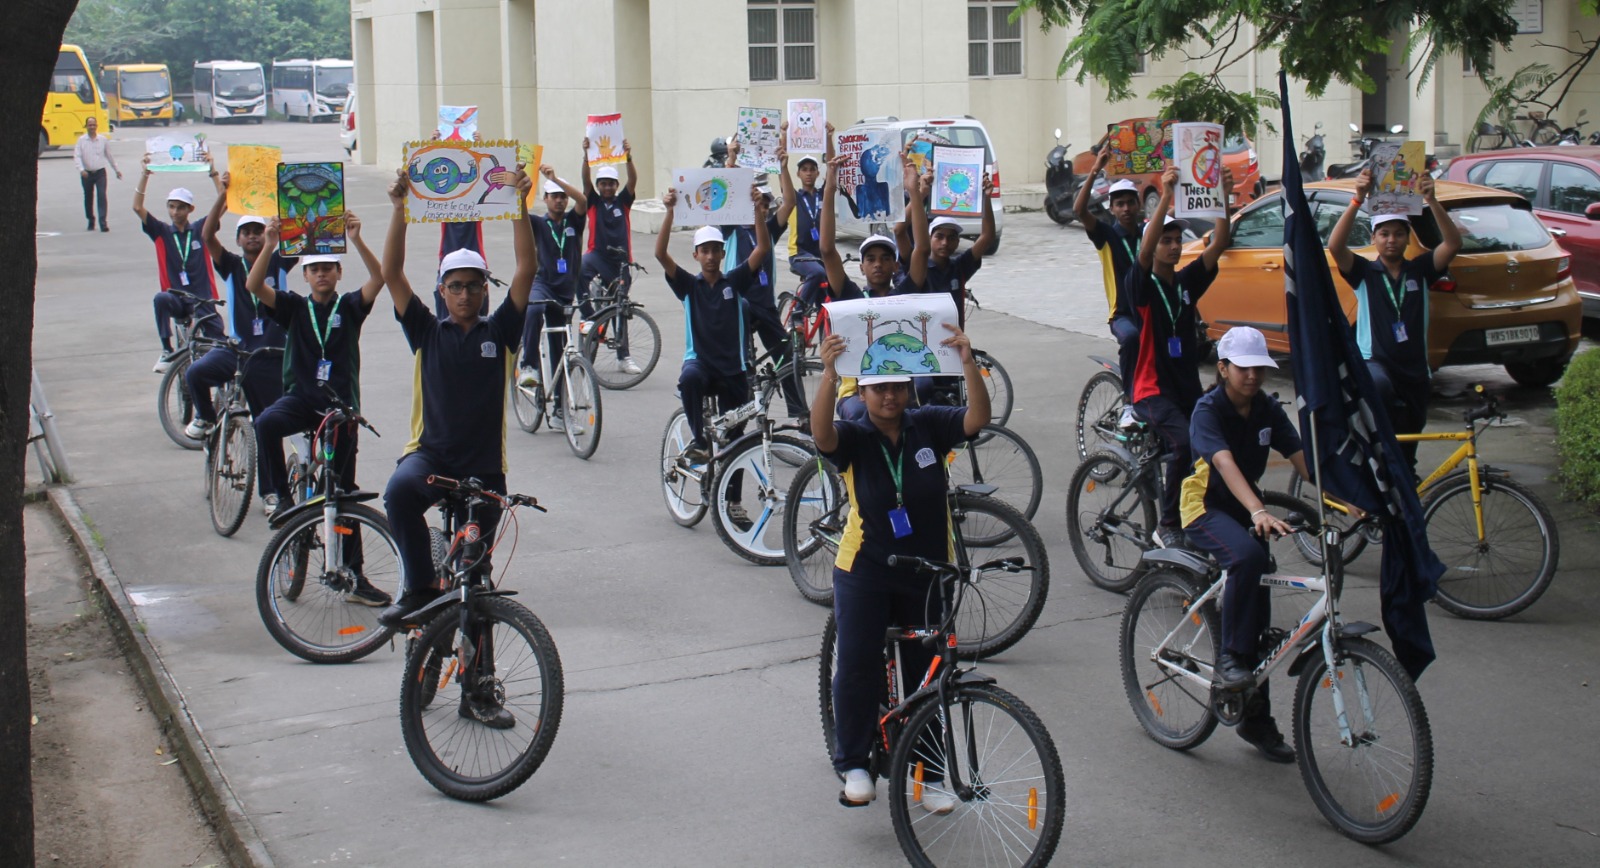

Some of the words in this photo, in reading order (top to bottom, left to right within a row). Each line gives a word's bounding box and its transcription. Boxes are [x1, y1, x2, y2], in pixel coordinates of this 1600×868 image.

[839, 168, 856, 176] LIKE
[839, 175, 857, 186] FIRE
[1181, 183, 1210, 196] THESE
[1188, 197, 1211, 210] BAD
